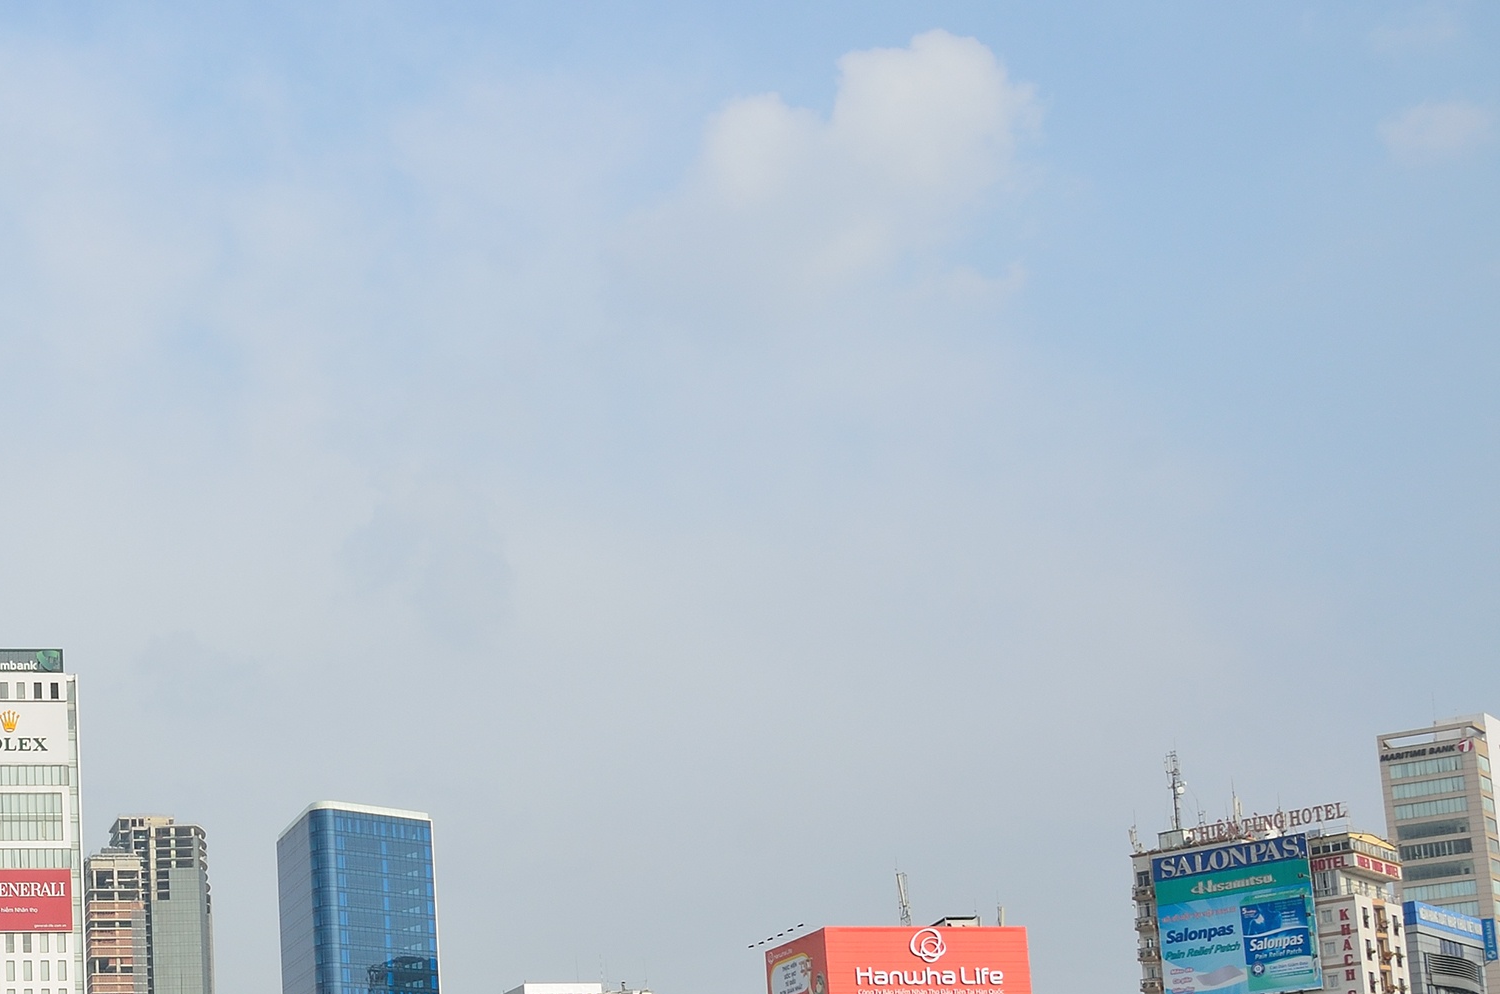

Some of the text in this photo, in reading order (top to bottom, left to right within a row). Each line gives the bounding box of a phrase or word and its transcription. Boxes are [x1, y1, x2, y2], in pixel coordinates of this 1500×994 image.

[1380, 744, 1456, 762] MARITIME BANK
[1241, 811, 1286, 835] TÙNG
[1288, 801, 1347, 828] HOTEL
[1160, 834, 1299, 880] SALONPAS
[1310, 855, 1349, 874] HOTEL
[1166, 924, 1234, 944] Salonpas
[1249, 933, 1304, 952] Salonpas
[1165, 941, 1241, 961] Pain Relief Patch
[1255, 952, 1268, 961] Pain
[1269, 949, 1285, 959] Relief
[1339, 908, 1356, 982] KHÁCH
[856, 966, 1004, 986] Hanwha Life
